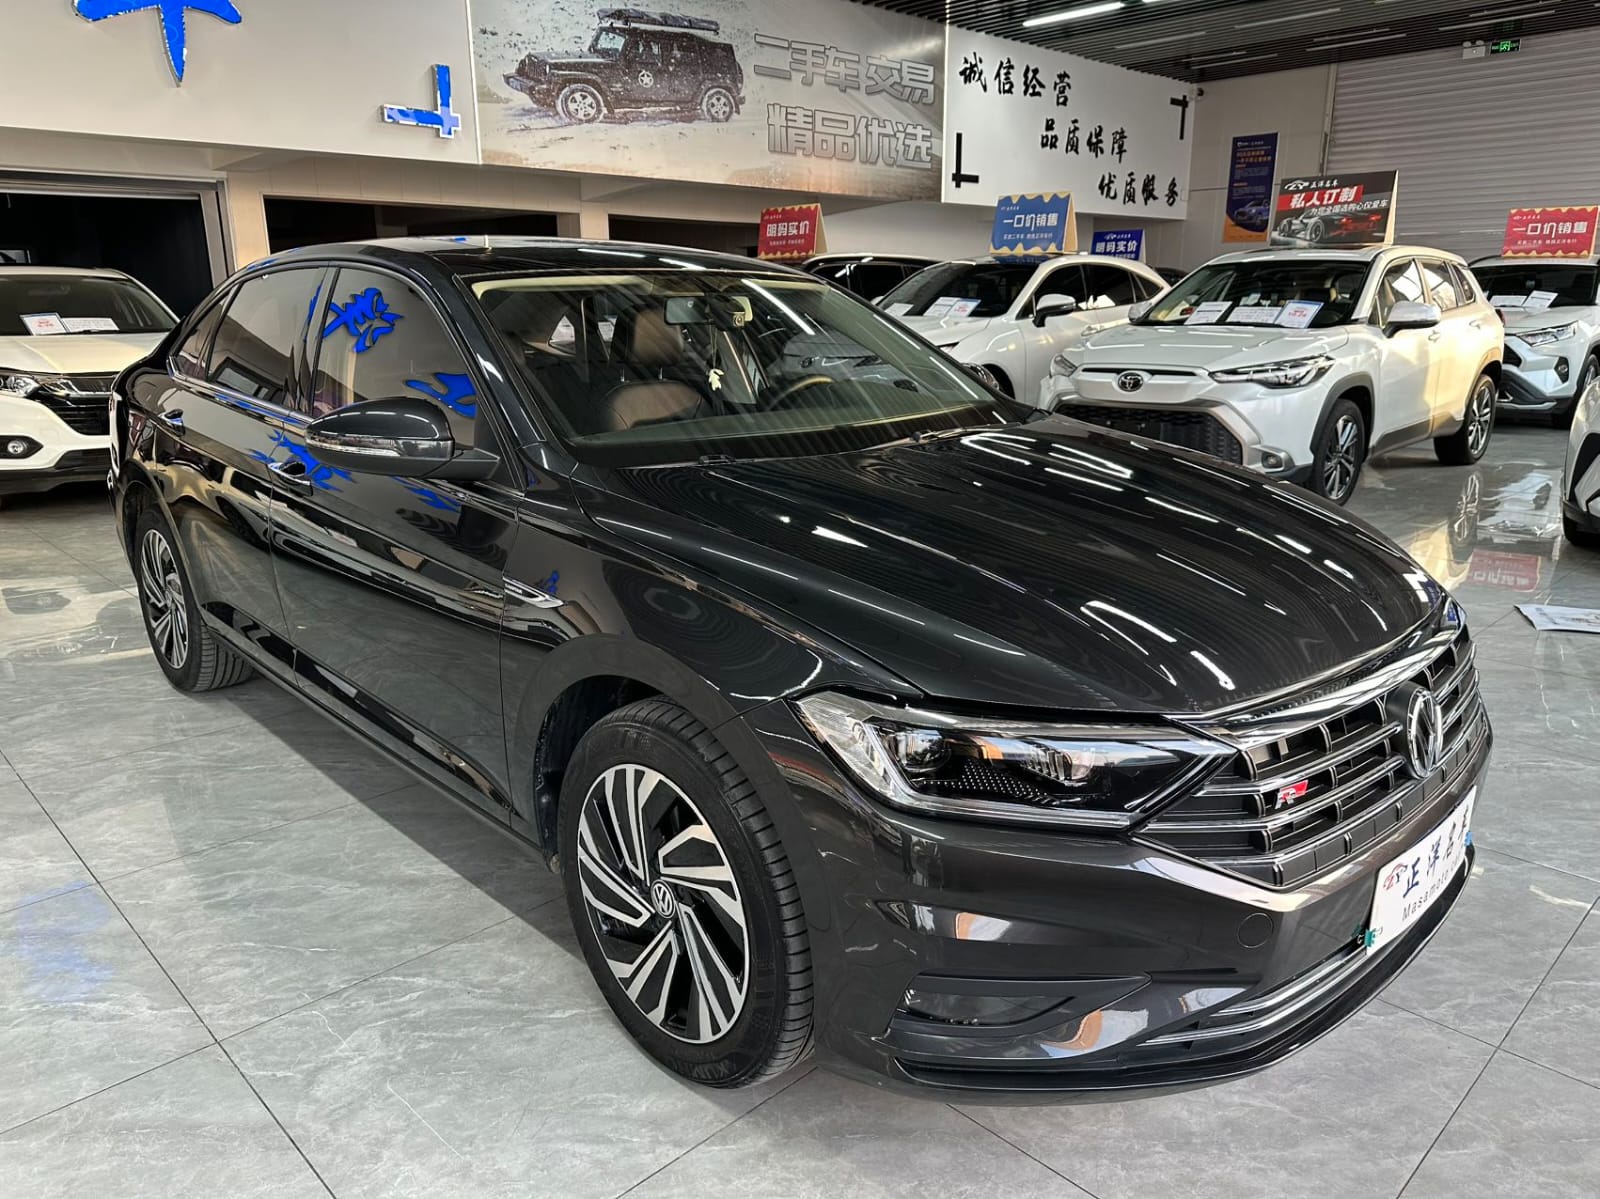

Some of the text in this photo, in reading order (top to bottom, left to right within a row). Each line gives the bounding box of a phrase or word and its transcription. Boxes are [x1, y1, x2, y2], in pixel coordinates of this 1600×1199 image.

[754, 33, 935, 105] 二手车交易
[959, 52, 1072, 107] 诚信经营
[767, 103, 932, 169] 精品优选
[1041, 118, 1128, 163] 品质保障
[1098, 172, 1179, 207] 优质服务
[1290, 186, 1357, 208] 私人订制
[767, 220, 809, 237] 明码实价
[1003, 213, 1059, 231] 一口价销售
[1512, 221, 1588, 238] 一口价销售
[1095, 240, 1138, 253] 明码实价
